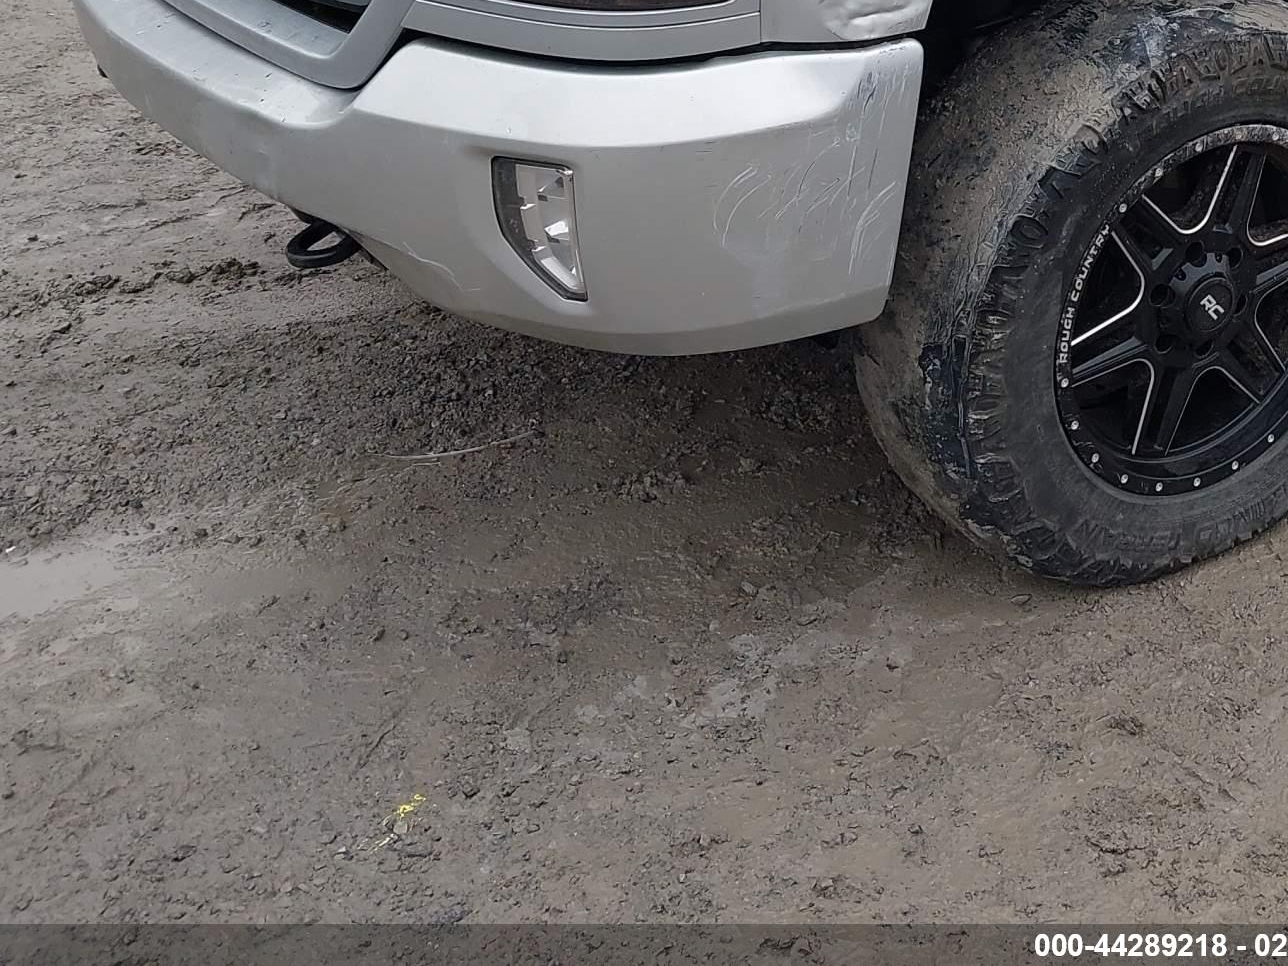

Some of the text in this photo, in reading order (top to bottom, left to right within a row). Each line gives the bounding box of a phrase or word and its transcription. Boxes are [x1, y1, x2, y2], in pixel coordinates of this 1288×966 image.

[1060, 224, 1110, 364] ROUGH COUNTRY
[1200, 294, 1225, 320] RC
